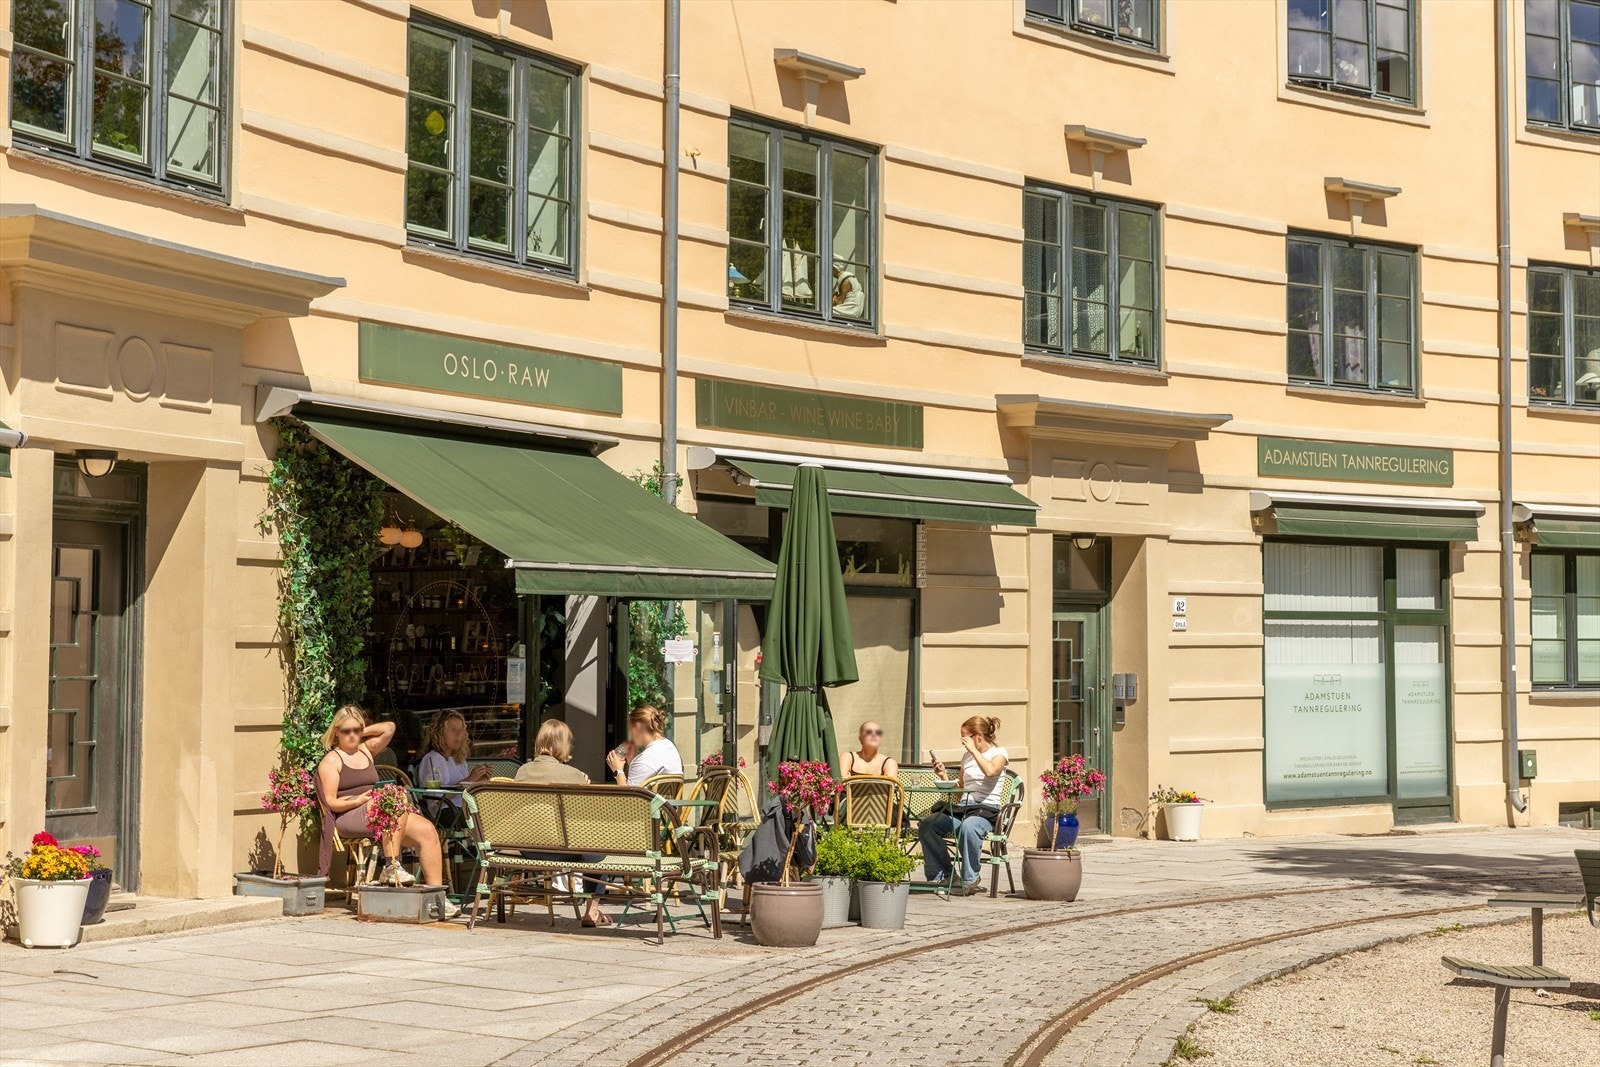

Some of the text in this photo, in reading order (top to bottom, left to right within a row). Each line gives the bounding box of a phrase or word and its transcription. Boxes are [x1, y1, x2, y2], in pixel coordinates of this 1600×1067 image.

[724, 395, 777, 419] VINBAR
[789, 404, 825, 426] WINE
[828, 408, 863, 430] WINE
[866, 413, 901, 433] BABY
[1264, 449, 1449, 475] ADAMSTUEN TANNREGULERING
[1056, 559, 1066, 574] B
[1176, 600, 1185, 612] 82
[1304, 692, 1351, 700] ADAMSTUEN
[1293, 704, 1362, 713] TANNREGULERING
[1283, 770, 1372, 778] www.adamstuentannregulering.no
